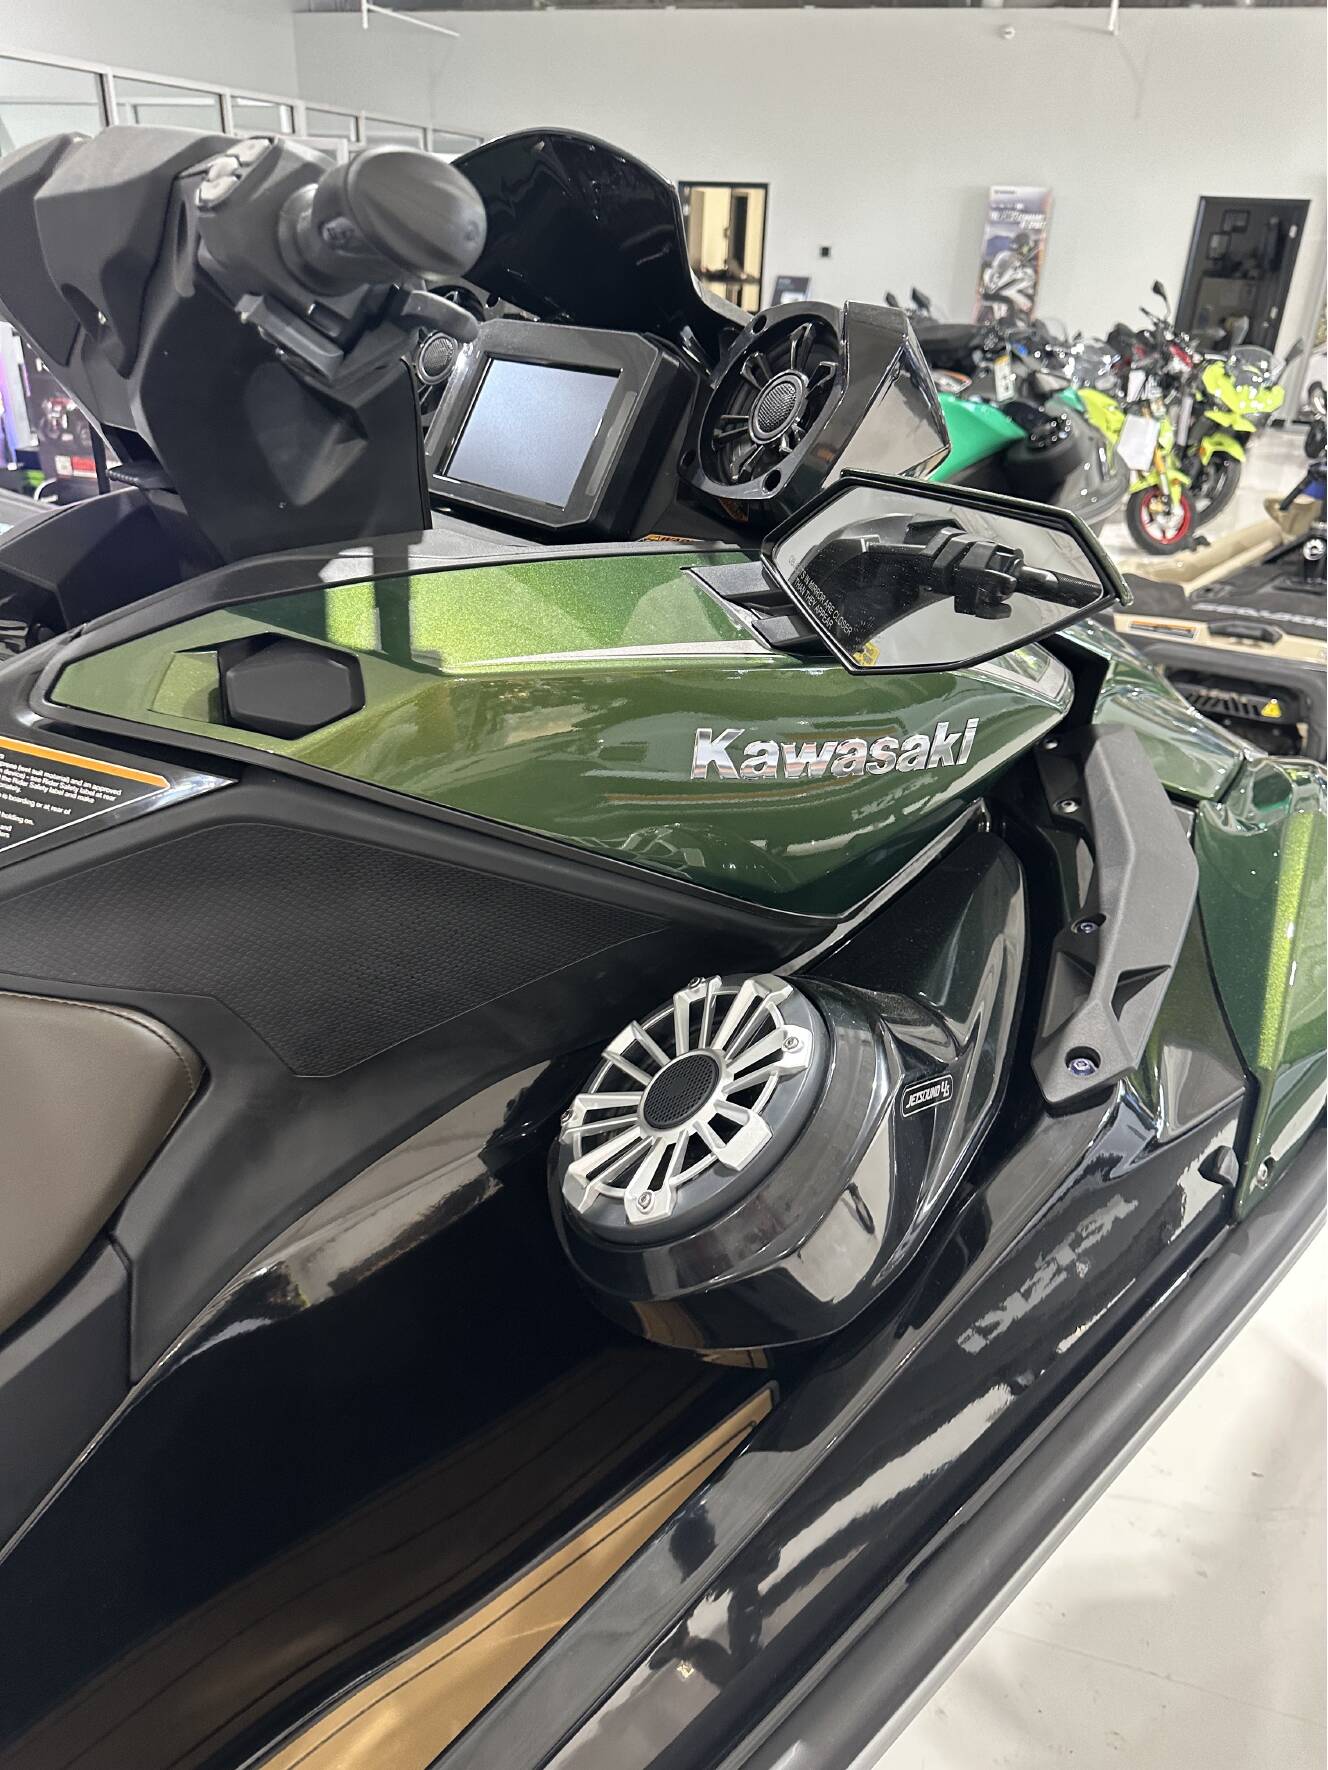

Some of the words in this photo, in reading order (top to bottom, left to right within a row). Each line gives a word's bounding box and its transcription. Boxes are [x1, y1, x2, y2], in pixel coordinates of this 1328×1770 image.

[794, 577, 806, 595] THAN
[805, 590, 817, 607] THEY
[814, 605, 834, 630] APPEAR
[808, 580, 826, 603] MIRROR
[823, 600, 835, 614] ARE
[832, 610, 853, 636] CLOSER
[690, 717, 979, 780] Kawasaki
[12, 777, 29, 787] Rider
[29, 781, 49, 793] Safety
[49, 787, 65, 796] label
[64, 791, 77, 799] and
[77, 795, 95, 804] make
[42, 778, 60, 787] Rider
[59, 782, 79, 794] Safety
[79, 787, 96, 797] label
[103, 794, 116, 802] rear
[70, 778, 83, 786] and
[92, 784, 122, 796] approved
[8, 793, 35, 808] boarding
[51, 805, 63, 813] rear
[1, 811, 24, 824] holding
[905, 1084, 941, 1109] JETSOUND
